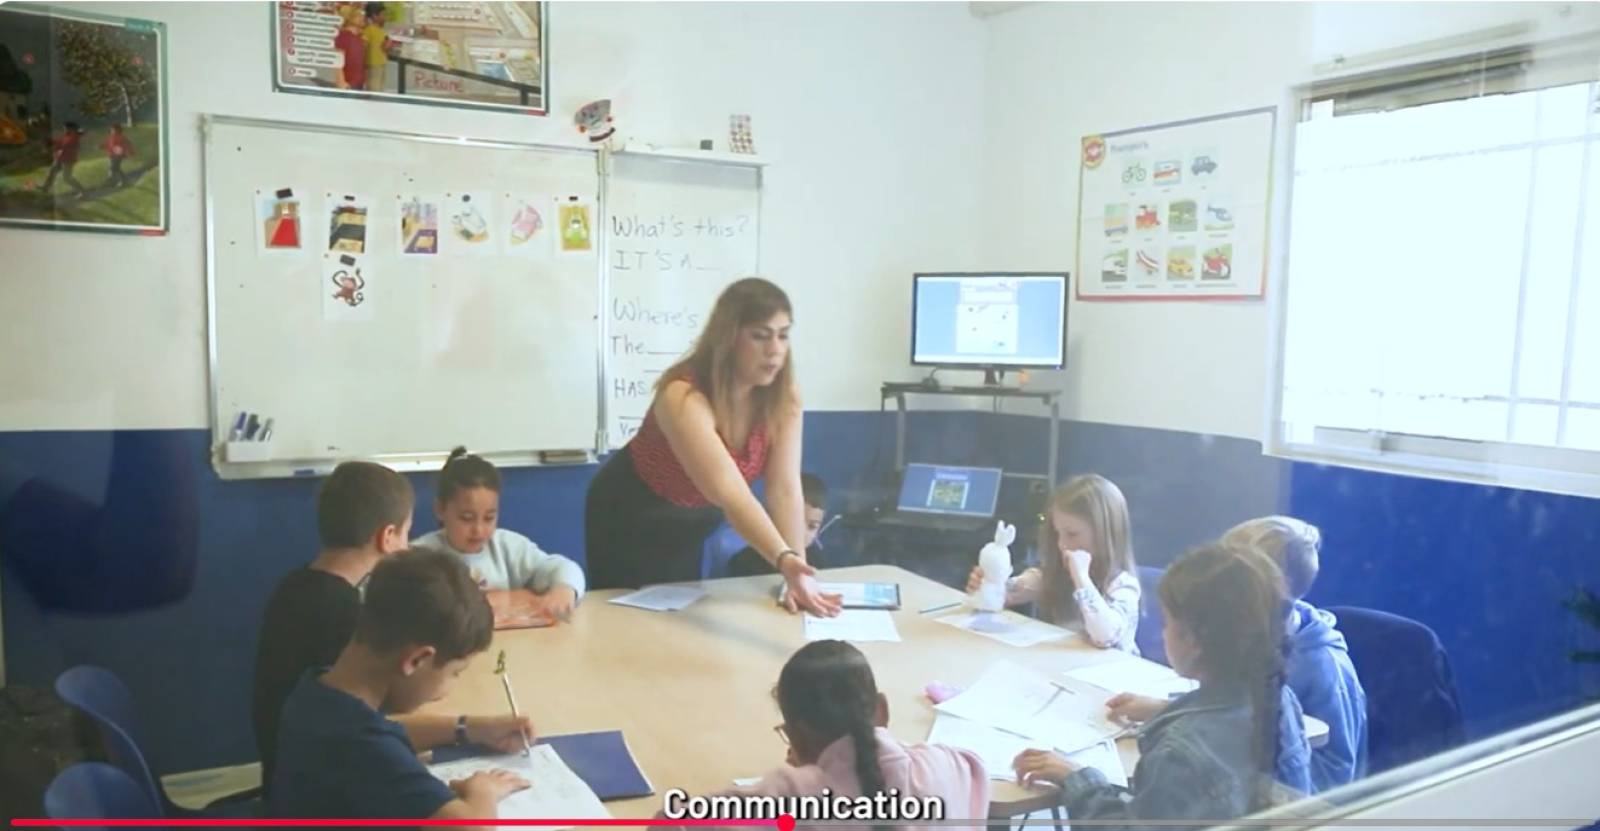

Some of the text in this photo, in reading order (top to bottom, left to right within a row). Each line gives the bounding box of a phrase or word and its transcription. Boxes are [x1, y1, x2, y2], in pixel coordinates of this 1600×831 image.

[612, 214, 749, 238] What's this?
[613, 250, 672, 270] IT'S
[612, 298, 698, 328] Where's
[610, 335, 644, 355] The
[614, 379, 647, 398] HAS
